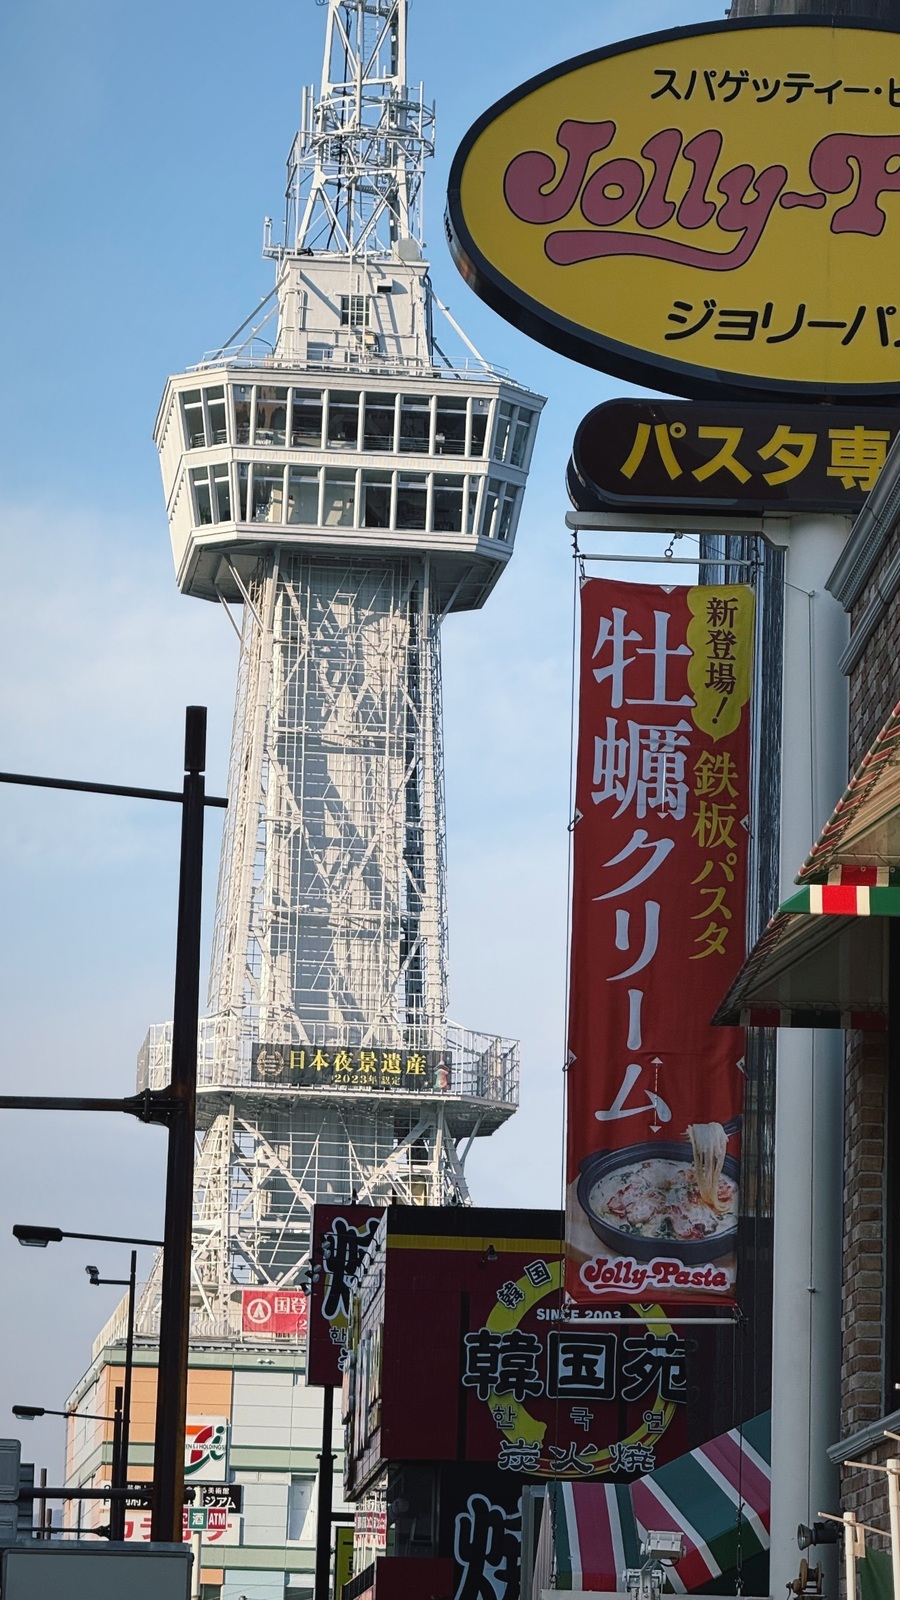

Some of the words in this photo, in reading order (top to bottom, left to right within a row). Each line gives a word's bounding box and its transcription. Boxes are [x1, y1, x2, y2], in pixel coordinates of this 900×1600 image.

[664, 299, 900, 348] ジョリーパ
[619, 421, 891, 492] パスタ専
[591, 607, 697, 1123] 牡蠣クリーム
[689, 750, 740, 960] 鉄板パスタ
[289, 1049, 428, 1076] 日本夜景遺産
[582, 1257, 729, 1294] Jolly-Pasta
[462, 1328, 687, 1403] 韓国苑
[498, 1437, 656, 1474] 炭火焼
[192, 1512, 205, 1526] 酒
[208, 1512, 226, 1526] ATM
